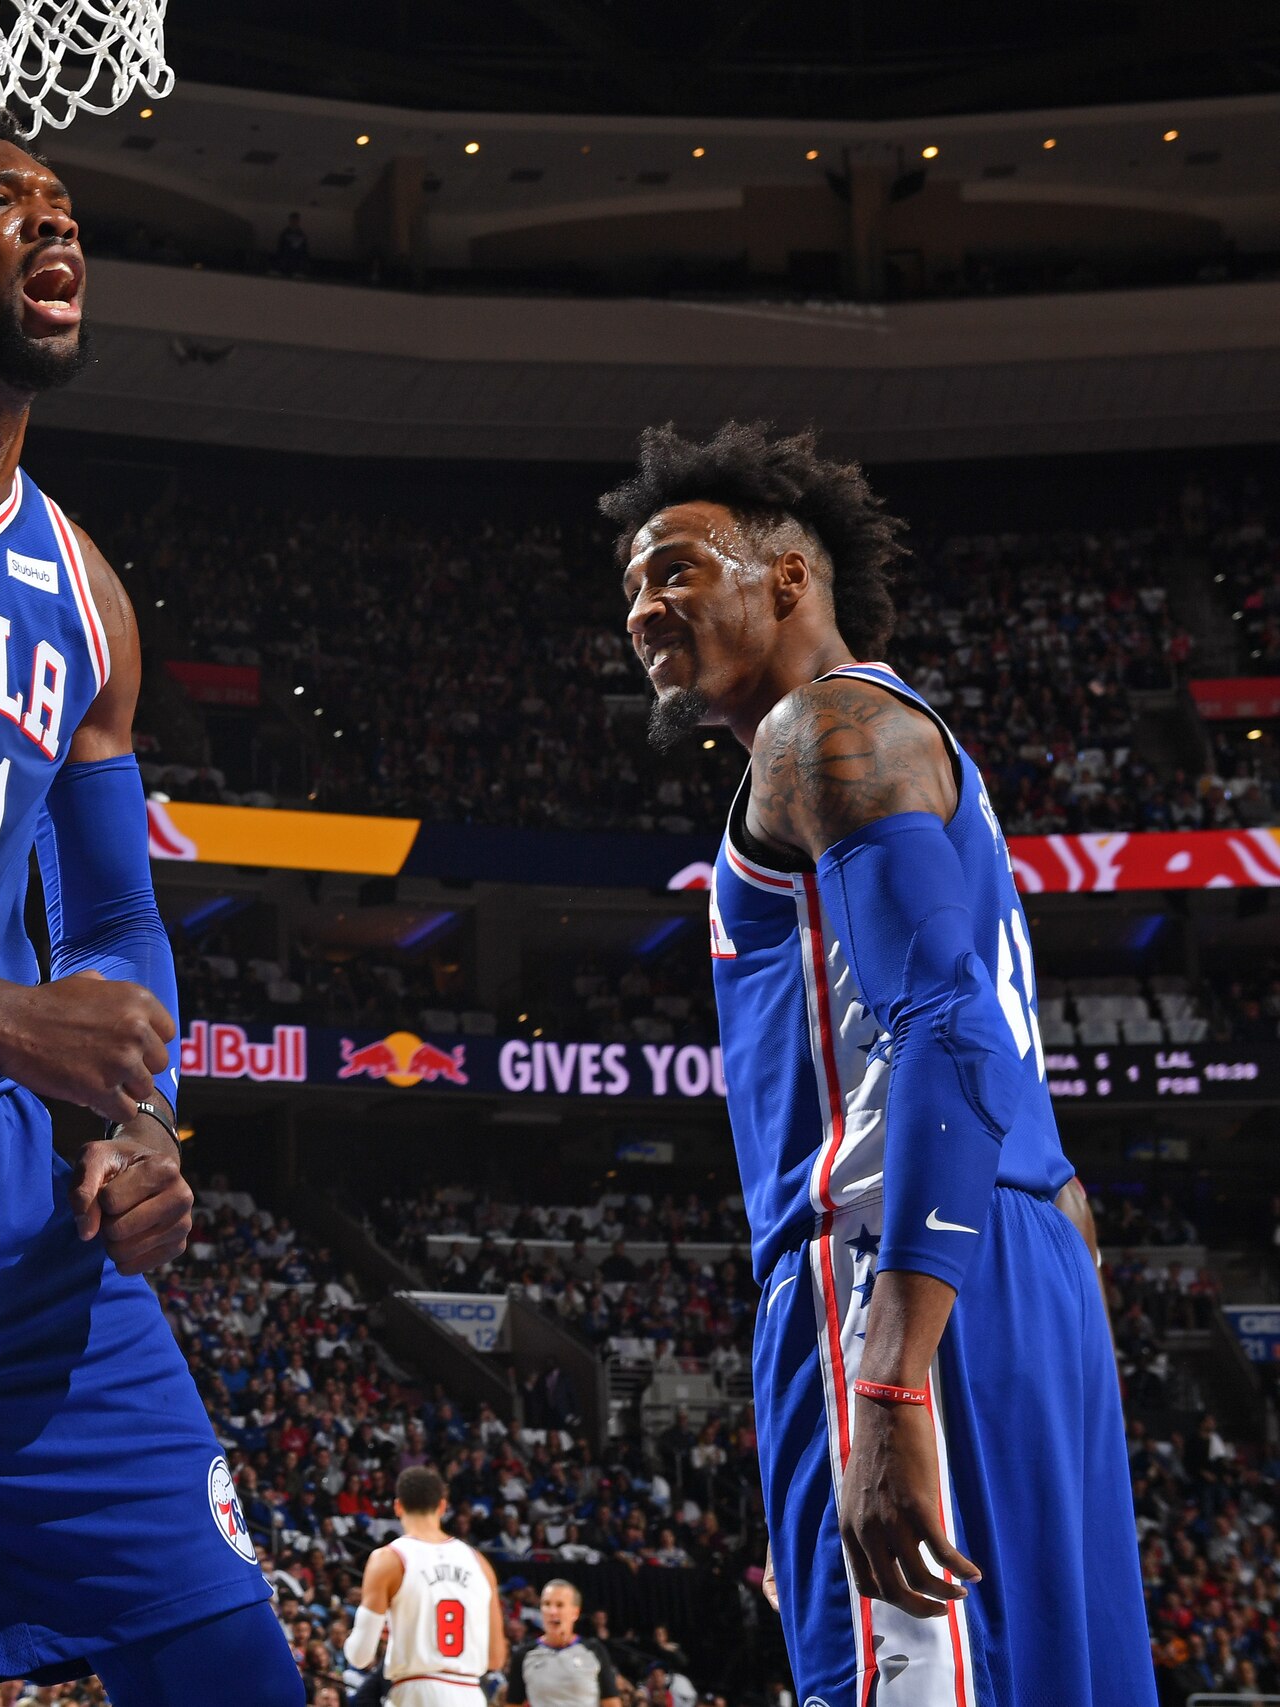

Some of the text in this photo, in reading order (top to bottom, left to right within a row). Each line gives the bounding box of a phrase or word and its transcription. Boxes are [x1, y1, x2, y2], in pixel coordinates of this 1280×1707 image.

[12, 559, 51, 583] StubHub
[210, 1023, 307, 1082] Bull
[498, 1039, 630, 1096] GIVES
[864, 1385, 891, 1396] NAME
[903, 1391, 926, 1400] PLAY
[436, 1599, 465, 1657] 8
